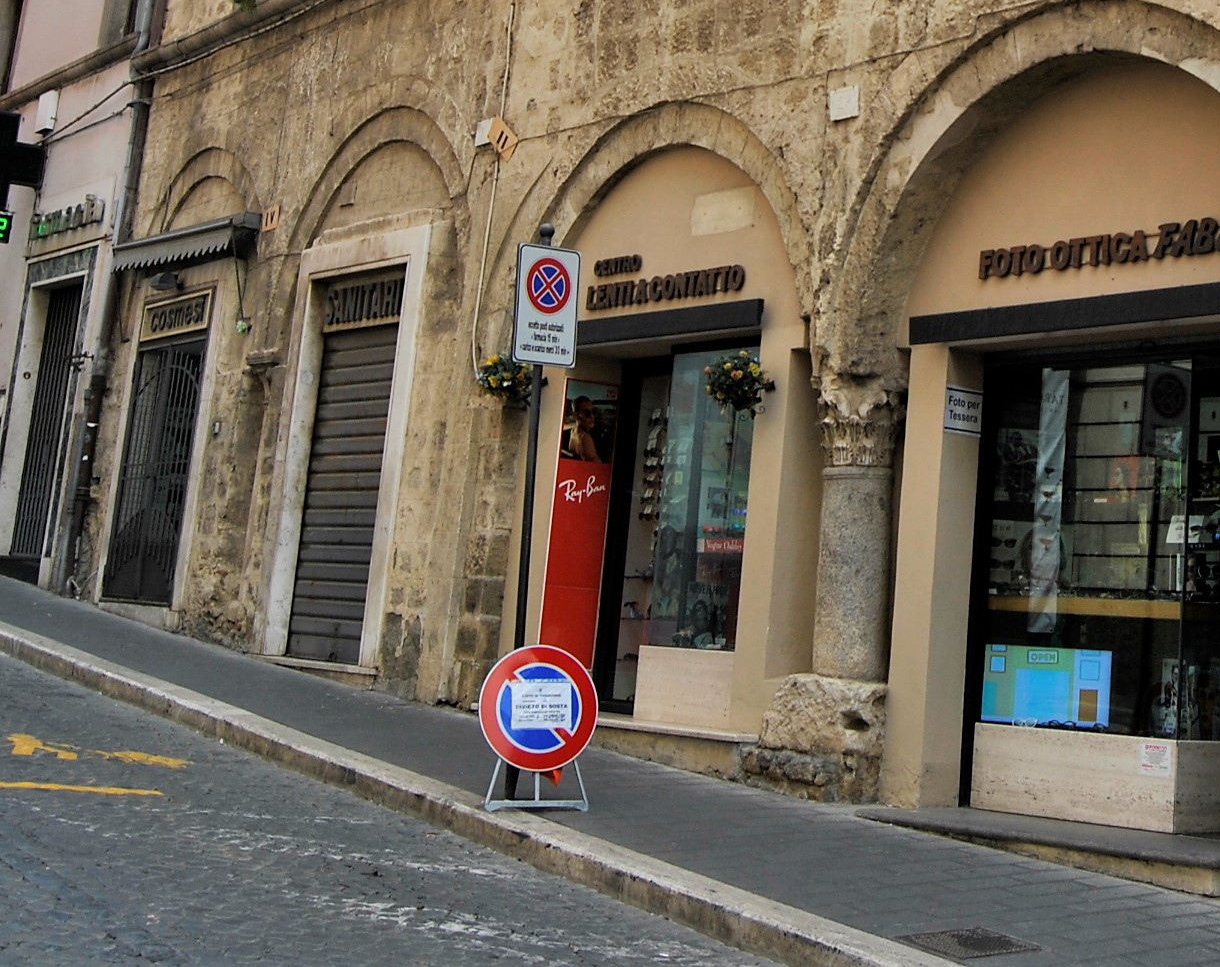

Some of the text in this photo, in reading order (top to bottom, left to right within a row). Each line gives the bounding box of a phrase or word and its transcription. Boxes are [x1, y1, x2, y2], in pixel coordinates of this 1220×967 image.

[594, 254, 642, 277] CENTRO
[978, 244, 1045, 280] FOTO
[1050, 230, 1149, 271] OTTICA
[586, 264, 746, 311] LENTI A CONTATTO
[325, 279, 403, 325] SANITARI
[948, 395, 980, 410] Foto per
[949, 409, 978, 424] Tessera
[1031, 653, 1056, 662] OPEN
